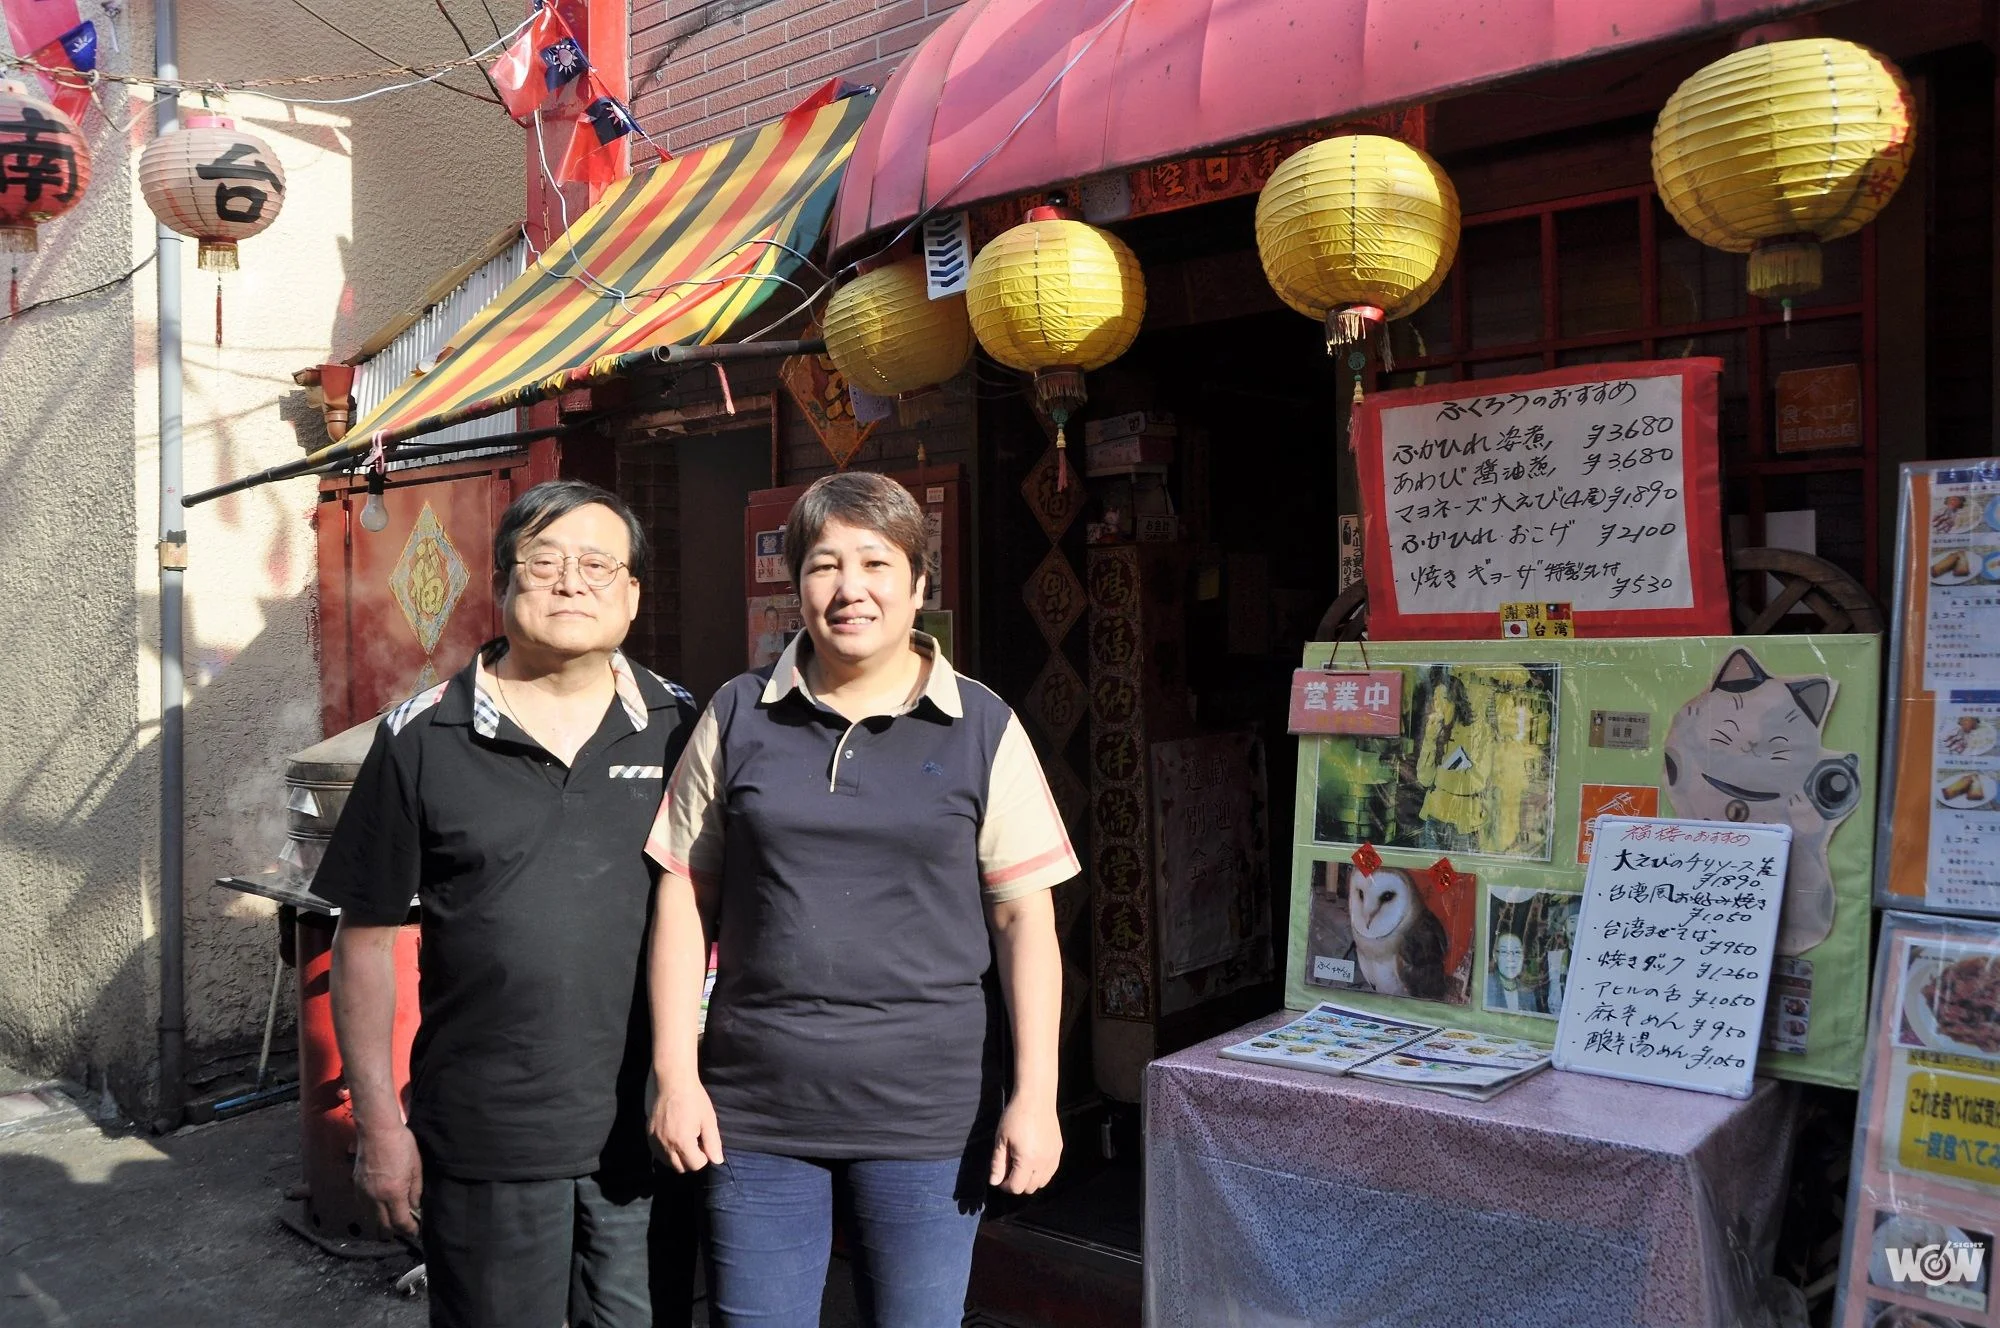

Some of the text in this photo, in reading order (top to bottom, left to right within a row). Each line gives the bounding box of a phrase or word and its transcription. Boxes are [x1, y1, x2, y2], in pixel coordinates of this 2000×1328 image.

[0, 107, 79, 203] 南
[195, 143, 283, 223] 台
[1609, 574, 1673, 600] ¥530
[1534, 621, 1569, 637] 台湾
[1303, 680, 1390, 712] 営業中
